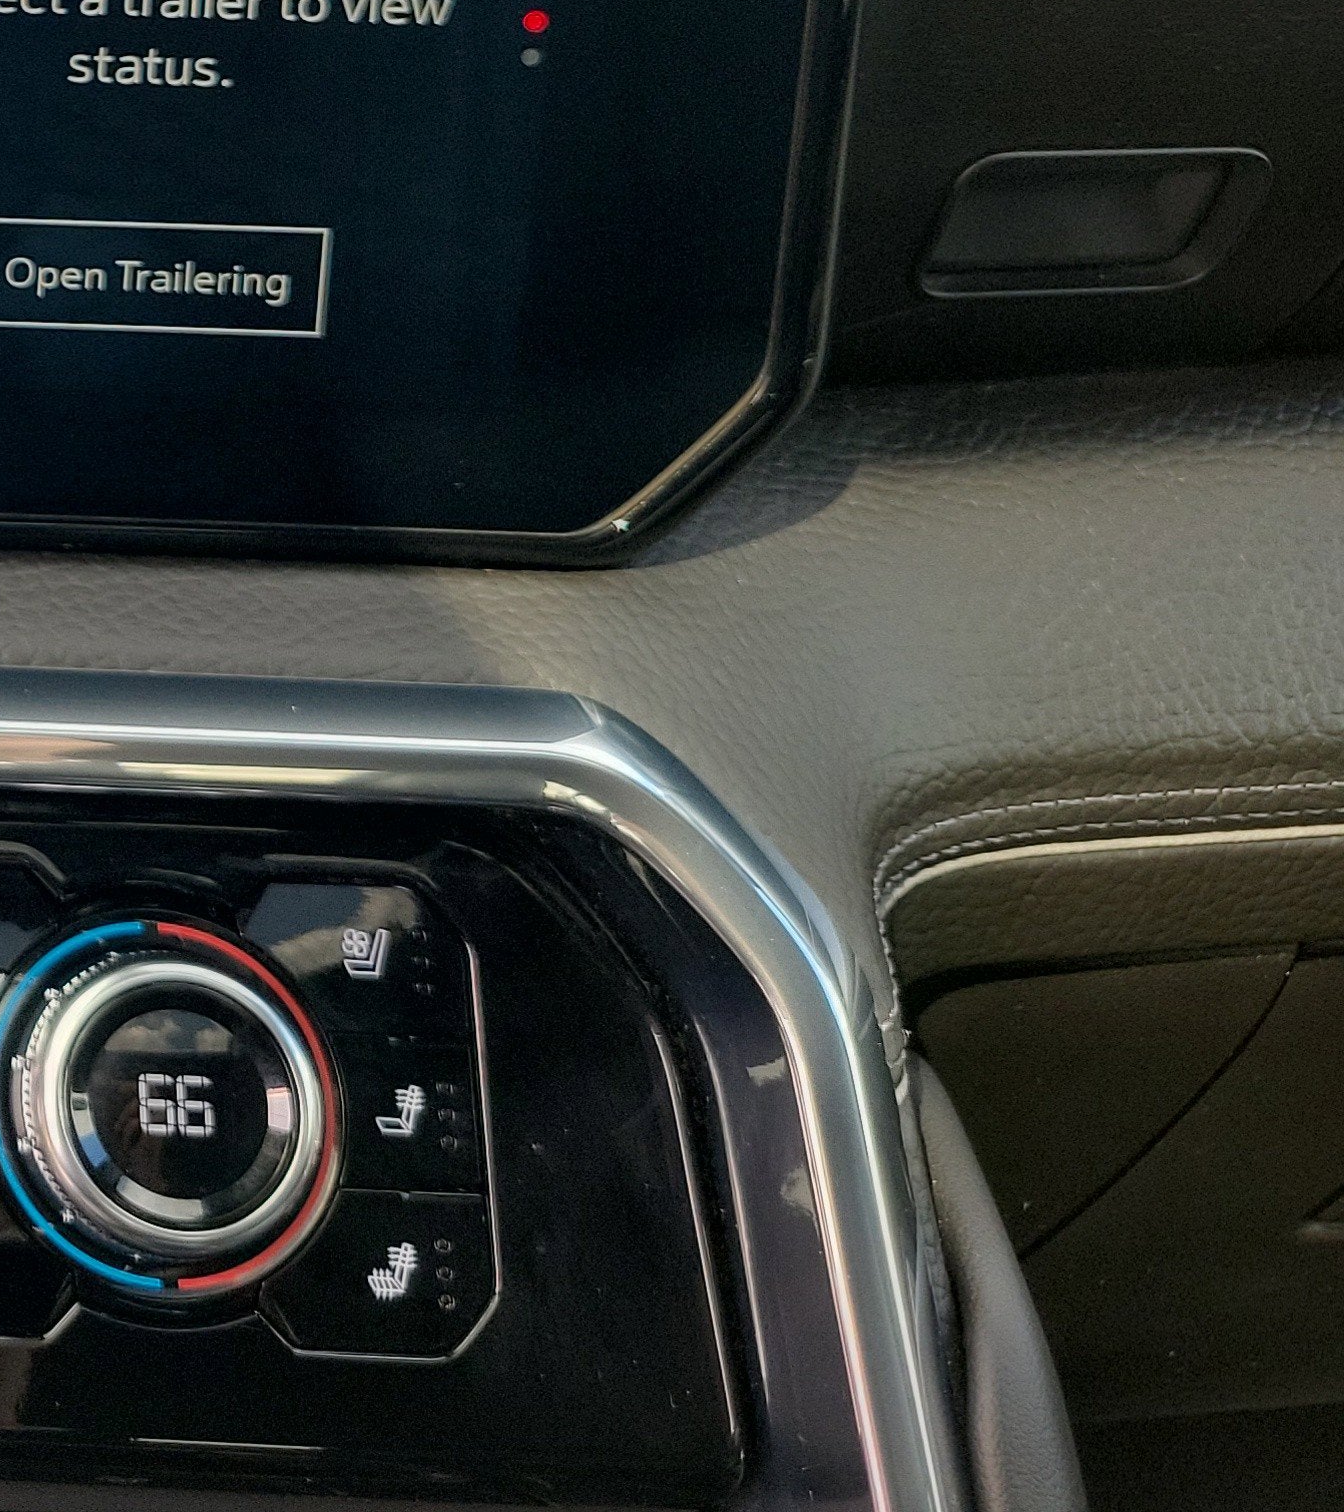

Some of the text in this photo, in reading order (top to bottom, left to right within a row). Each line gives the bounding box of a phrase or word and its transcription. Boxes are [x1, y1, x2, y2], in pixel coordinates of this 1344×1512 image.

[67, 46, 236, 88] status.
[5, 257, 292, 308] Open Trailering
[138, 1073, 216, 1138] 66
